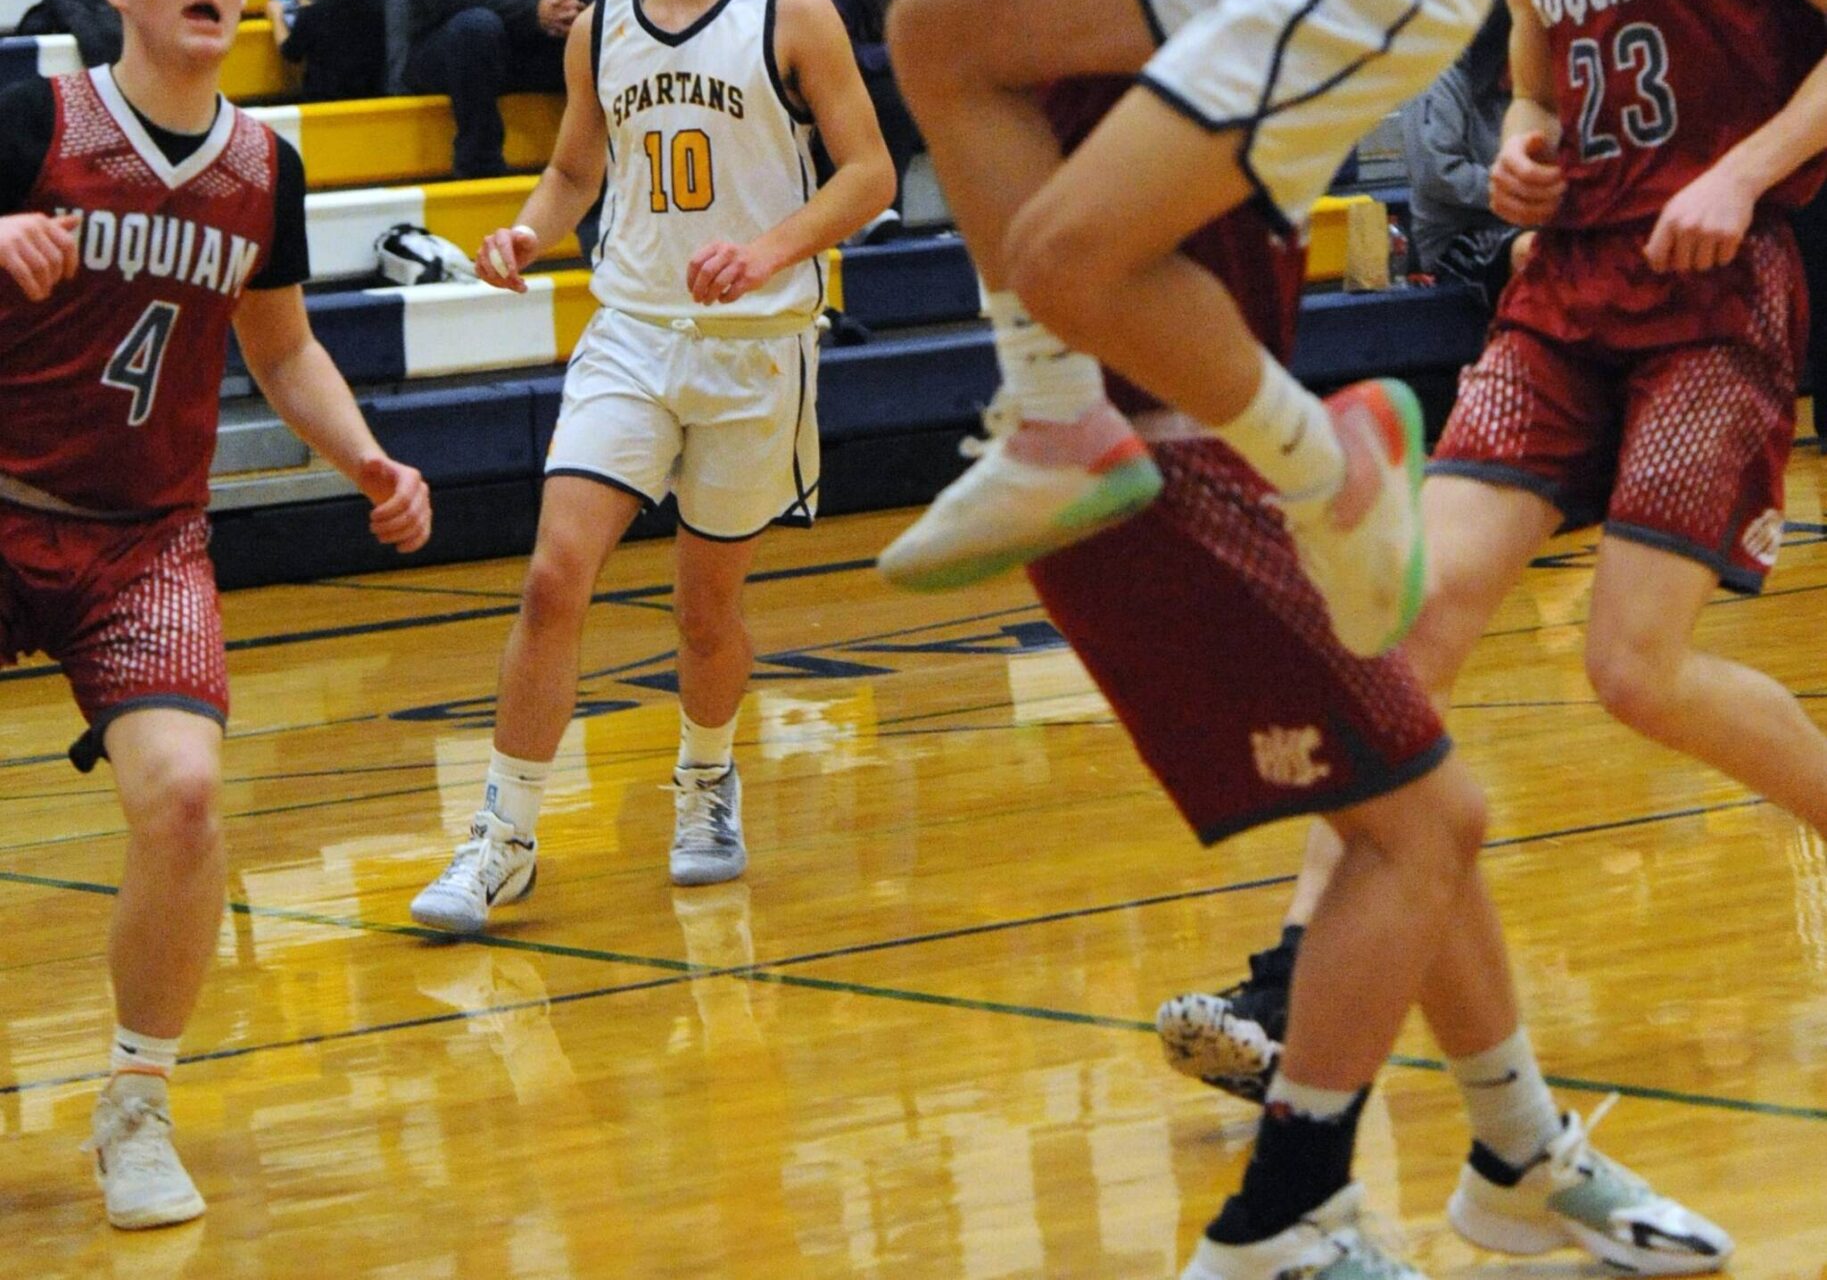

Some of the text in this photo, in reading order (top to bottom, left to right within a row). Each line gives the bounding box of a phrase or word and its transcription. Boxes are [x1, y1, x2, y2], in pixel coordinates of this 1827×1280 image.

[612, 71, 745, 128] SPARTANS
[1568, 22, 1678, 163] 23
[643, 127, 716, 214] 10
[100, 299, 182, 428] 4
